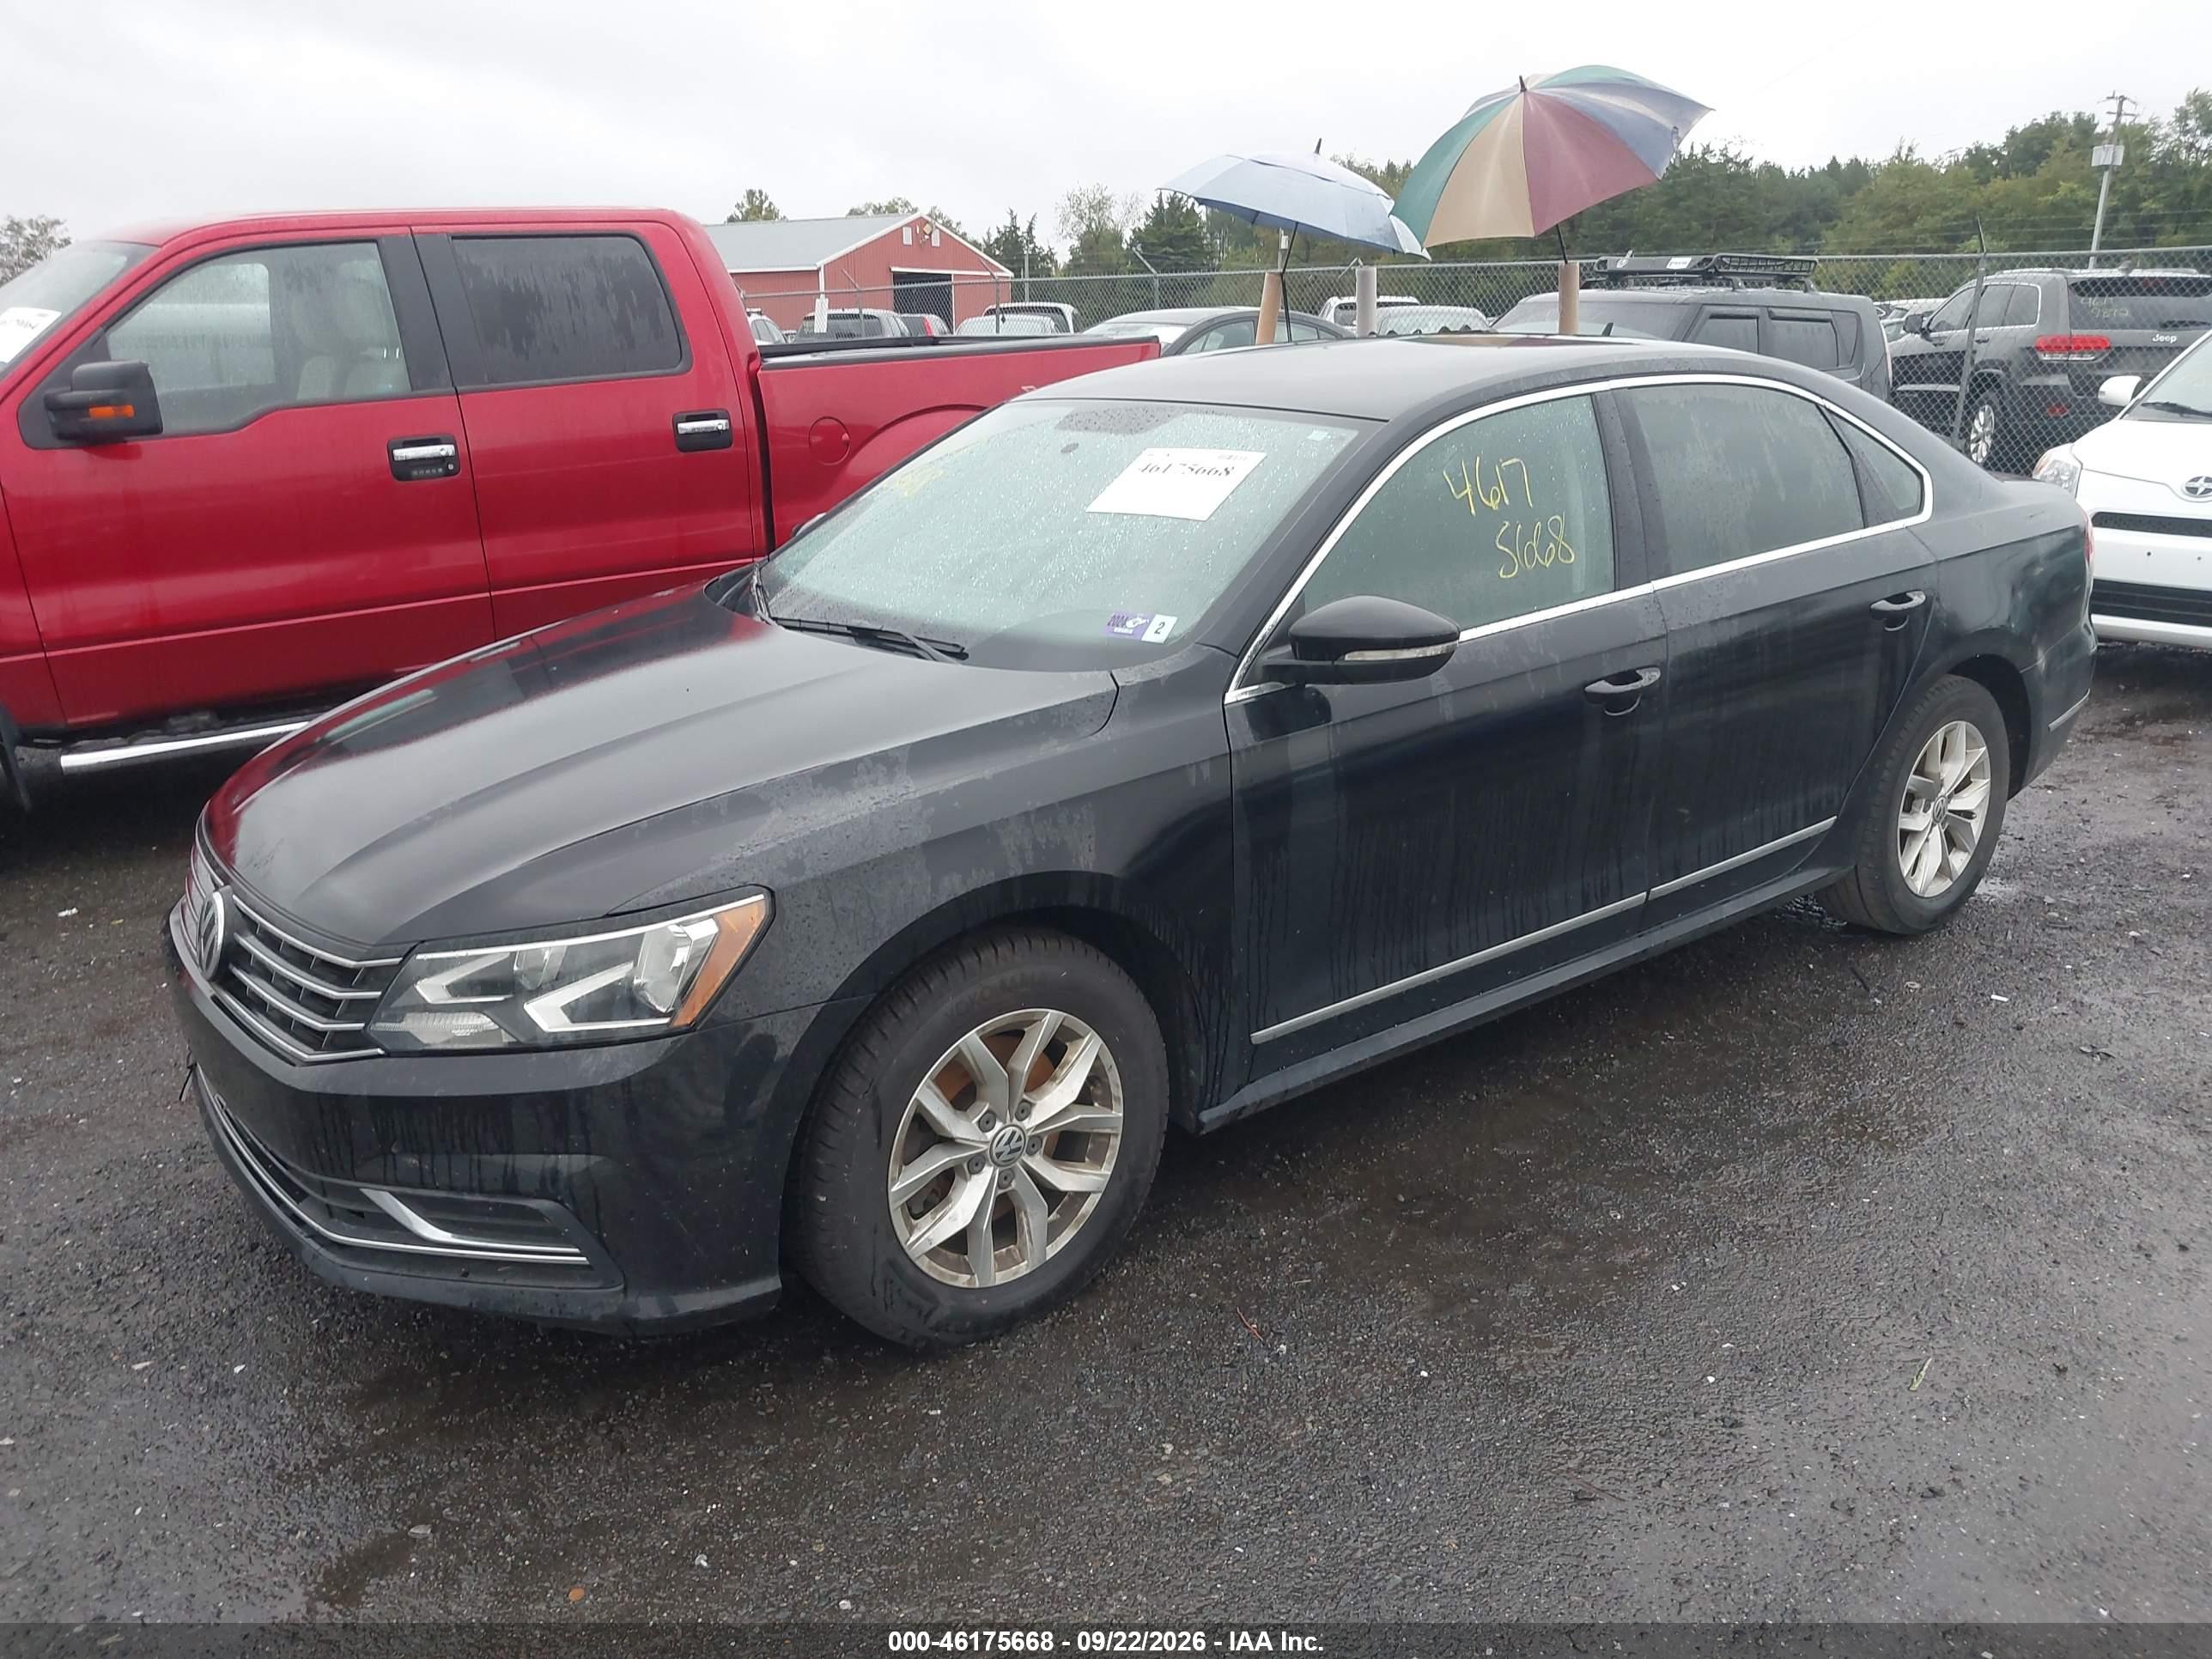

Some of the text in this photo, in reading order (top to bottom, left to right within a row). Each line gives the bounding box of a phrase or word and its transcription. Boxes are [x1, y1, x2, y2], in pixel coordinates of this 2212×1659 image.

[2152, 333, 2178, 343] Jeep
[1443, 455, 1533, 516] 4617
[1495, 511, 1575, 578] 5668
[1154, 621, 1166, 635] 2
